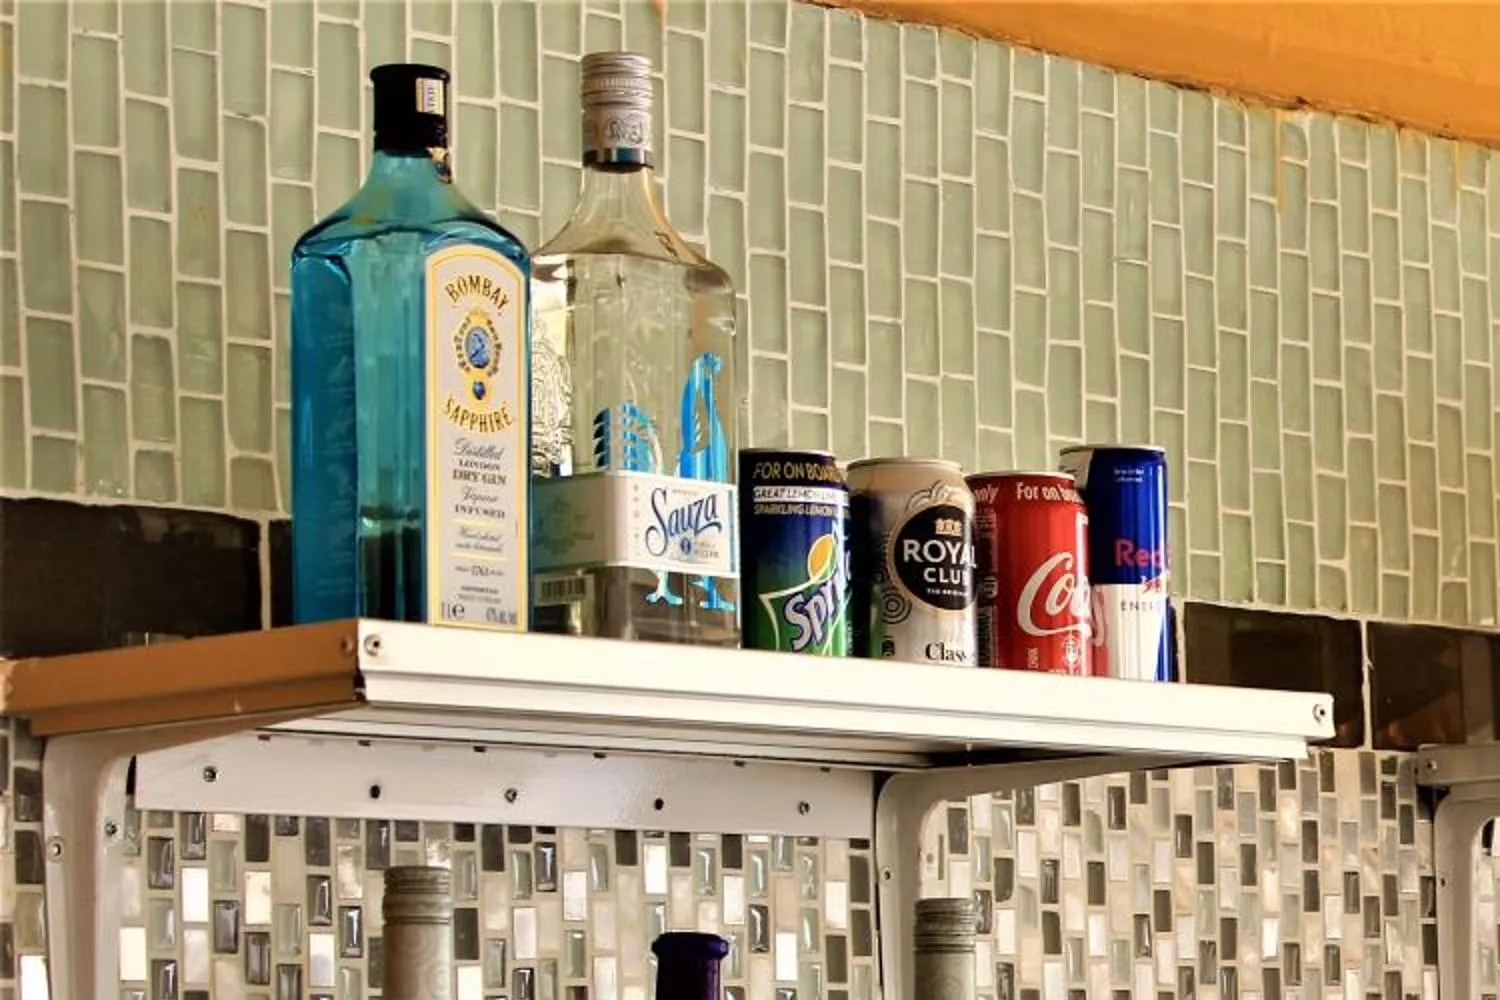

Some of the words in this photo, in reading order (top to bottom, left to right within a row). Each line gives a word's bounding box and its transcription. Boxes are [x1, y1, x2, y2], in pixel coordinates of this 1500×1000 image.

[444, 274, 510, 312] BOMBAY
[442, 396, 514, 434] SAPPHIRE
[452, 469, 480, 483] DRY
[481, 472, 508, 486] GIN
[752, 461, 782, 480] FOR
[783, 463, 805, 480] ON
[753, 486, 786, 500] GREAT
[1016, 481, 1039, 500] For
[454, 505, 506, 519] INFUSED
[645, 487, 723, 557] Sauza
[902, 537, 977, 569] ROYAL
